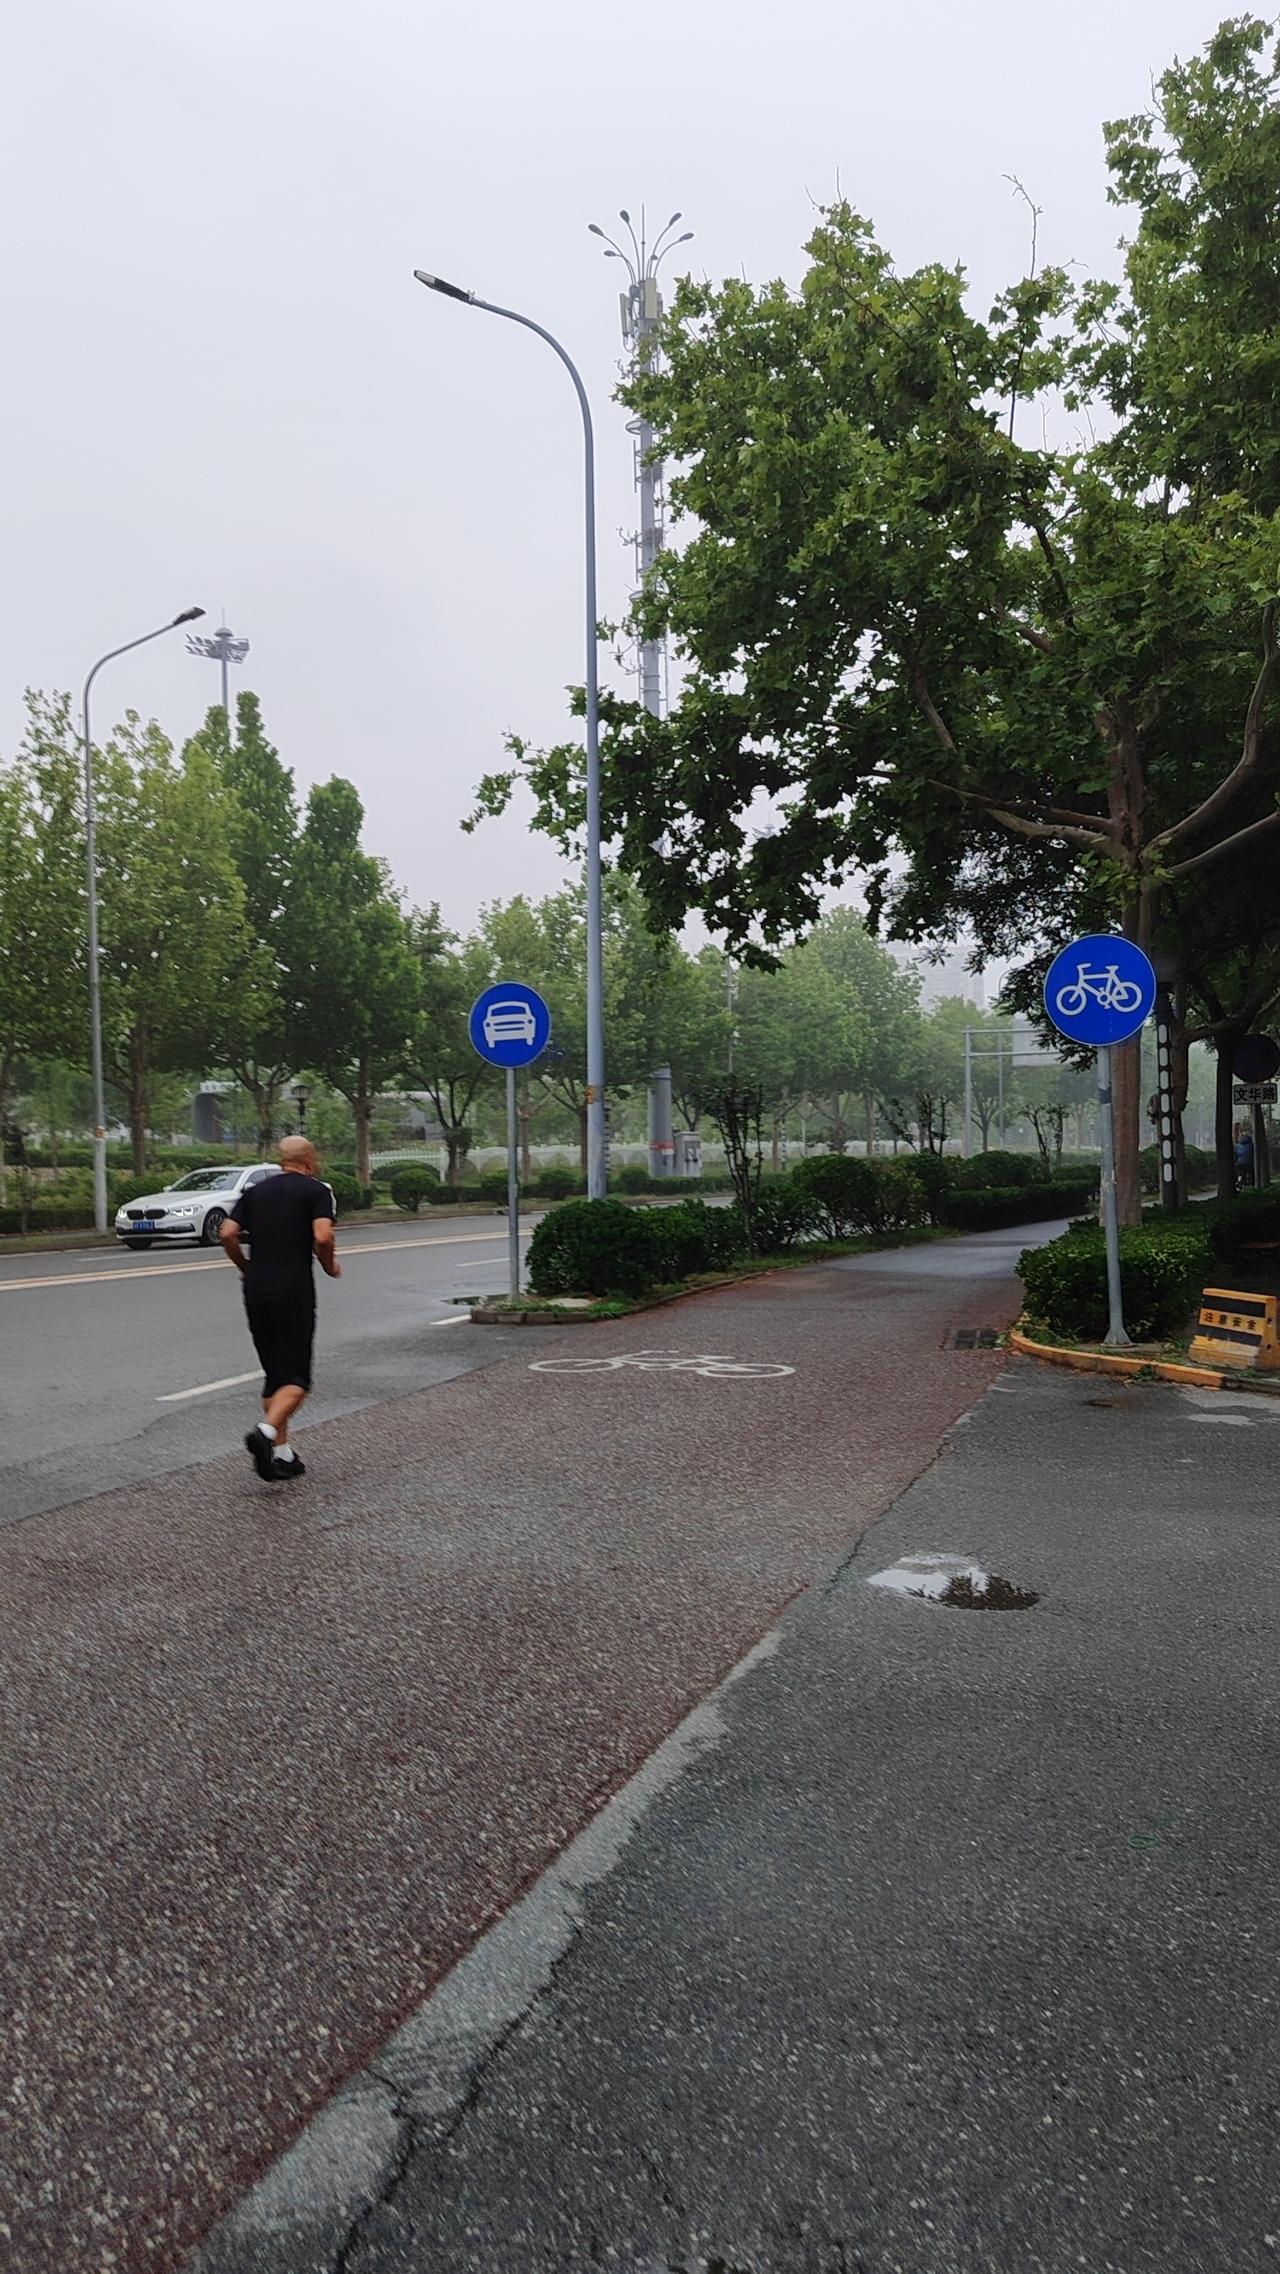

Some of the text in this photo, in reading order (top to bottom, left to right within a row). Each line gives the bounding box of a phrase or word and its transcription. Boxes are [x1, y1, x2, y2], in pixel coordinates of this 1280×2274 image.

[1235, 1087, 1275, 1102] 文华路
[1204, 1311, 1257, 1330] 注意安全
